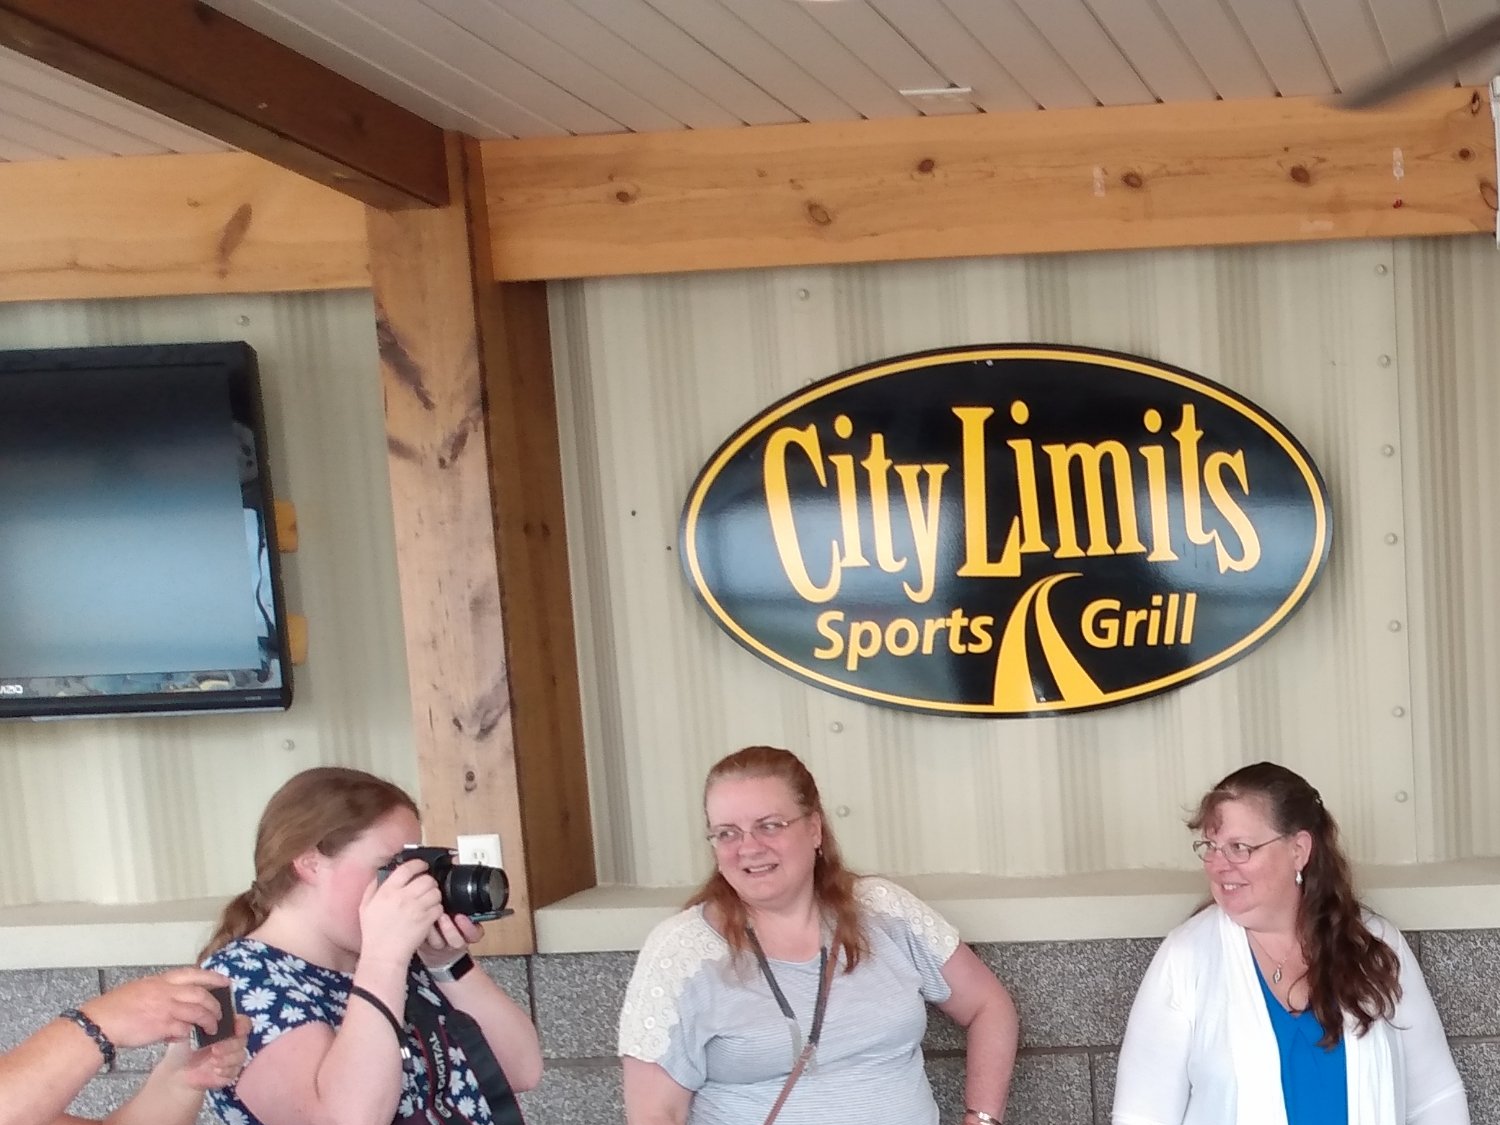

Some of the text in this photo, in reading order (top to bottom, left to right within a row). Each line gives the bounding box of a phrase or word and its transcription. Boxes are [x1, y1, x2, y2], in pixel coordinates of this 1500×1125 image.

[763, 400, 1262, 603] City Limits
[812, 592, 1198, 671] Sports Grill
[429, 1031, 447, 1089] DIGITAL
